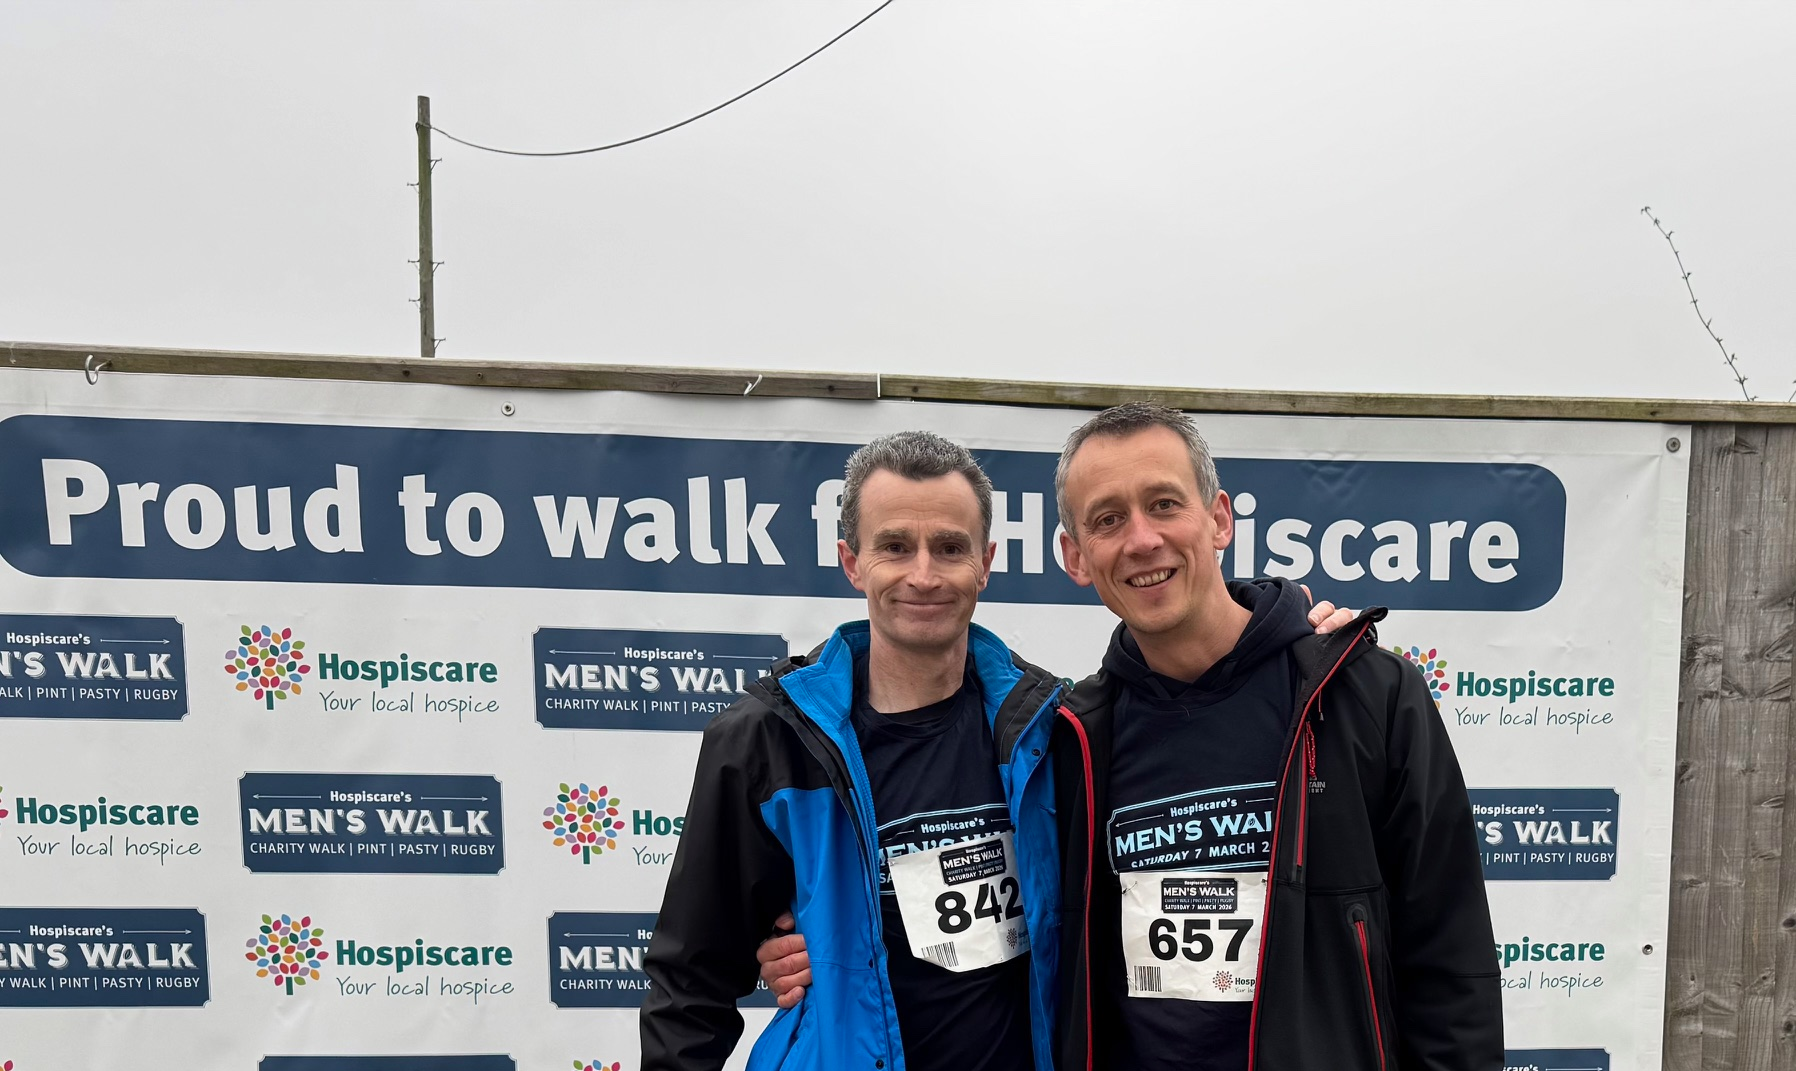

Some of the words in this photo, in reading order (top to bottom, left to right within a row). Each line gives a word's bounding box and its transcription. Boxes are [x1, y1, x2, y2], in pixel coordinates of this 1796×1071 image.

[41, 458, 364, 553] Proud
[397, 474, 505, 557] to
[533, 476, 786, 565] walk
[990, 490, 1520, 583] Hiscare
[6, 632, 91, 647] Hospiscare's
[55, 652, 177, 681] WALK
[624, 647, 704, 661] Hospiscare's
[318, 653, 498, 688] Hospiscare
[544, 663, 661, 692] MEN'S
[0, 686, 23, 698] ALK
[36, 687, 67, 699] PINT
[79, 688, 121, 700] PASTY
[134, 689, 178, 701] RUGBY
[1456, 670, 1615, 704] Hospiscare
[319, 692, 362, 712] Your
[371, 692, 414, 713] local
[424, 693, 499, 723] hospice
[545, 698, 599, 710] CHARITY
[603, 699, 638, 711] WALK
[651, 701, 680, 712] PINT
[1455, 706, 1490, 726] Your
[1499, 706, 1538, 726] local
[1546, 707, 1614, 735] hospice
[330, 790, 412, 806] Hospiscare's
[1170, 797, 1238, 817] Hospiscare's
[1472, 804, 1545, 817] Hospiscare's
[16, 796, 199, 832] Hospiscare
[248, 808, 367, 836] MEN'S
[376, 808, 492, 837] WALK
[921, 817, 985, 834] Hospiscare's
[1115, 820, 1204, 857] MEN'S
[1513, 821, 1615, 846] WALK
[17, 835, 60, 856] Your
[71, 835, 113, 856] local
[125, 836, 202, 866] hospice
[249, 842, 305, 855] CHARITY
[308, 842, 346, 855] WALK
[357, 843, 387, 856] PINT
[399, 843, 439, 856] PASTY
[451, 843, 495, 856] RUGBY
[632, 846, 673, 866] Your
[943, 853, 981, 869] MEN'S
[981, 848, 1003, 862] WALK
[1194, 848, 1202, 859] 7
[1209, 842, 1255, 858] MARCH
[1493, 853, 1520, 864] PINT
[1530, 852, 1566, 863] PASTY
[1575, 852, 1615, 863] RUGBY
[948, 871, 977, 883] SATURDAY
[1163, 887, 1197, 897] MEN'S
[1199, 887, 1235, 897] WALK
[935, 876, 1024, 935] 842
[29, 924, 114, 939] Hospiscare's
[1148, 917, 1254, 962] 657
[0, 943, 69, 970] N'S
[78, 943, 197, 970] WALK
[336, 939, 513, 973] Hospiscare
[559, 945, 649, 973] MEN'
[9, 977, 47, 988] WALK
[59, 977, 90, 988] PINT
[102, 977, 143, 989] PASTY
[156, 977, 200, 989] RUGBY
[336, 976, 377, 997] Your
[386, 975, 427, 997] local
[439, 978, 515, 1005] hospice
[560, 979, 613, 991] CHARITY
[616, 979, 651, 991] WALK
[1540, 971, 1604, 997] hospice
